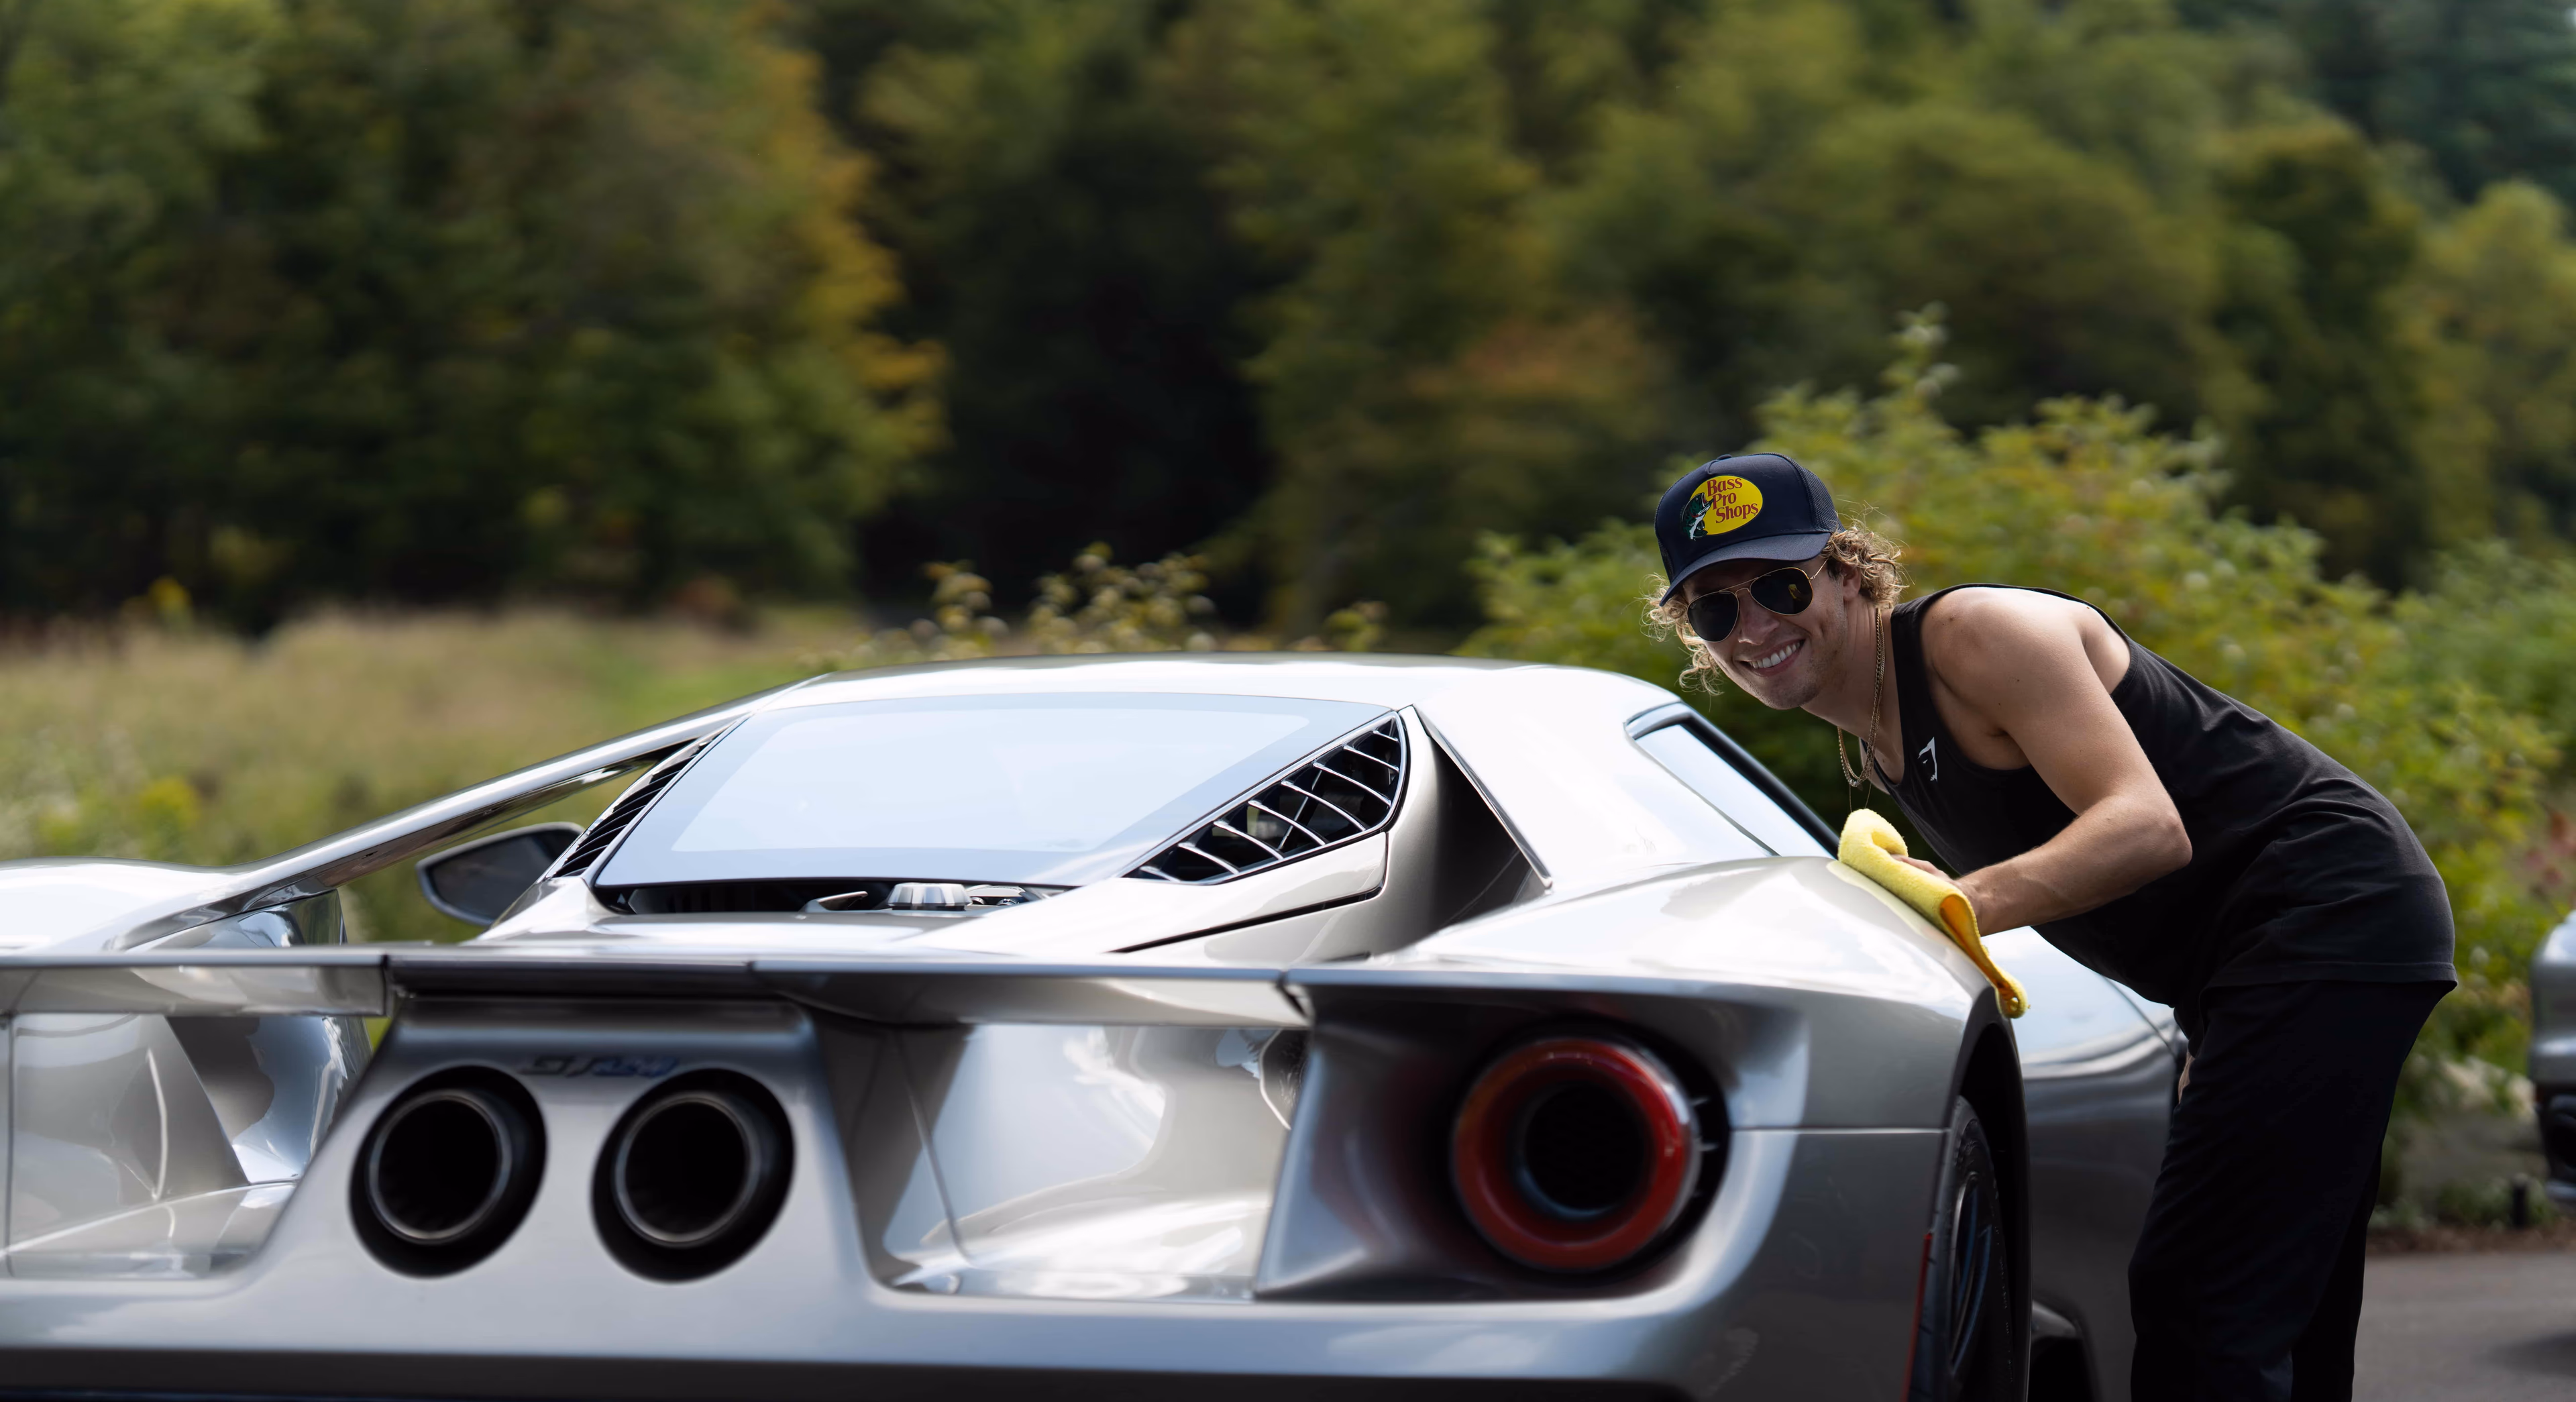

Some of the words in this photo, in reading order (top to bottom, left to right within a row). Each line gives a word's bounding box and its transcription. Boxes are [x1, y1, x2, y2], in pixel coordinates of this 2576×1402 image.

[1707, 478, 1743, 496] Bass
[1712, 493, 1737, 510] Pro
[1715, 503, 1758, 523] Shops
